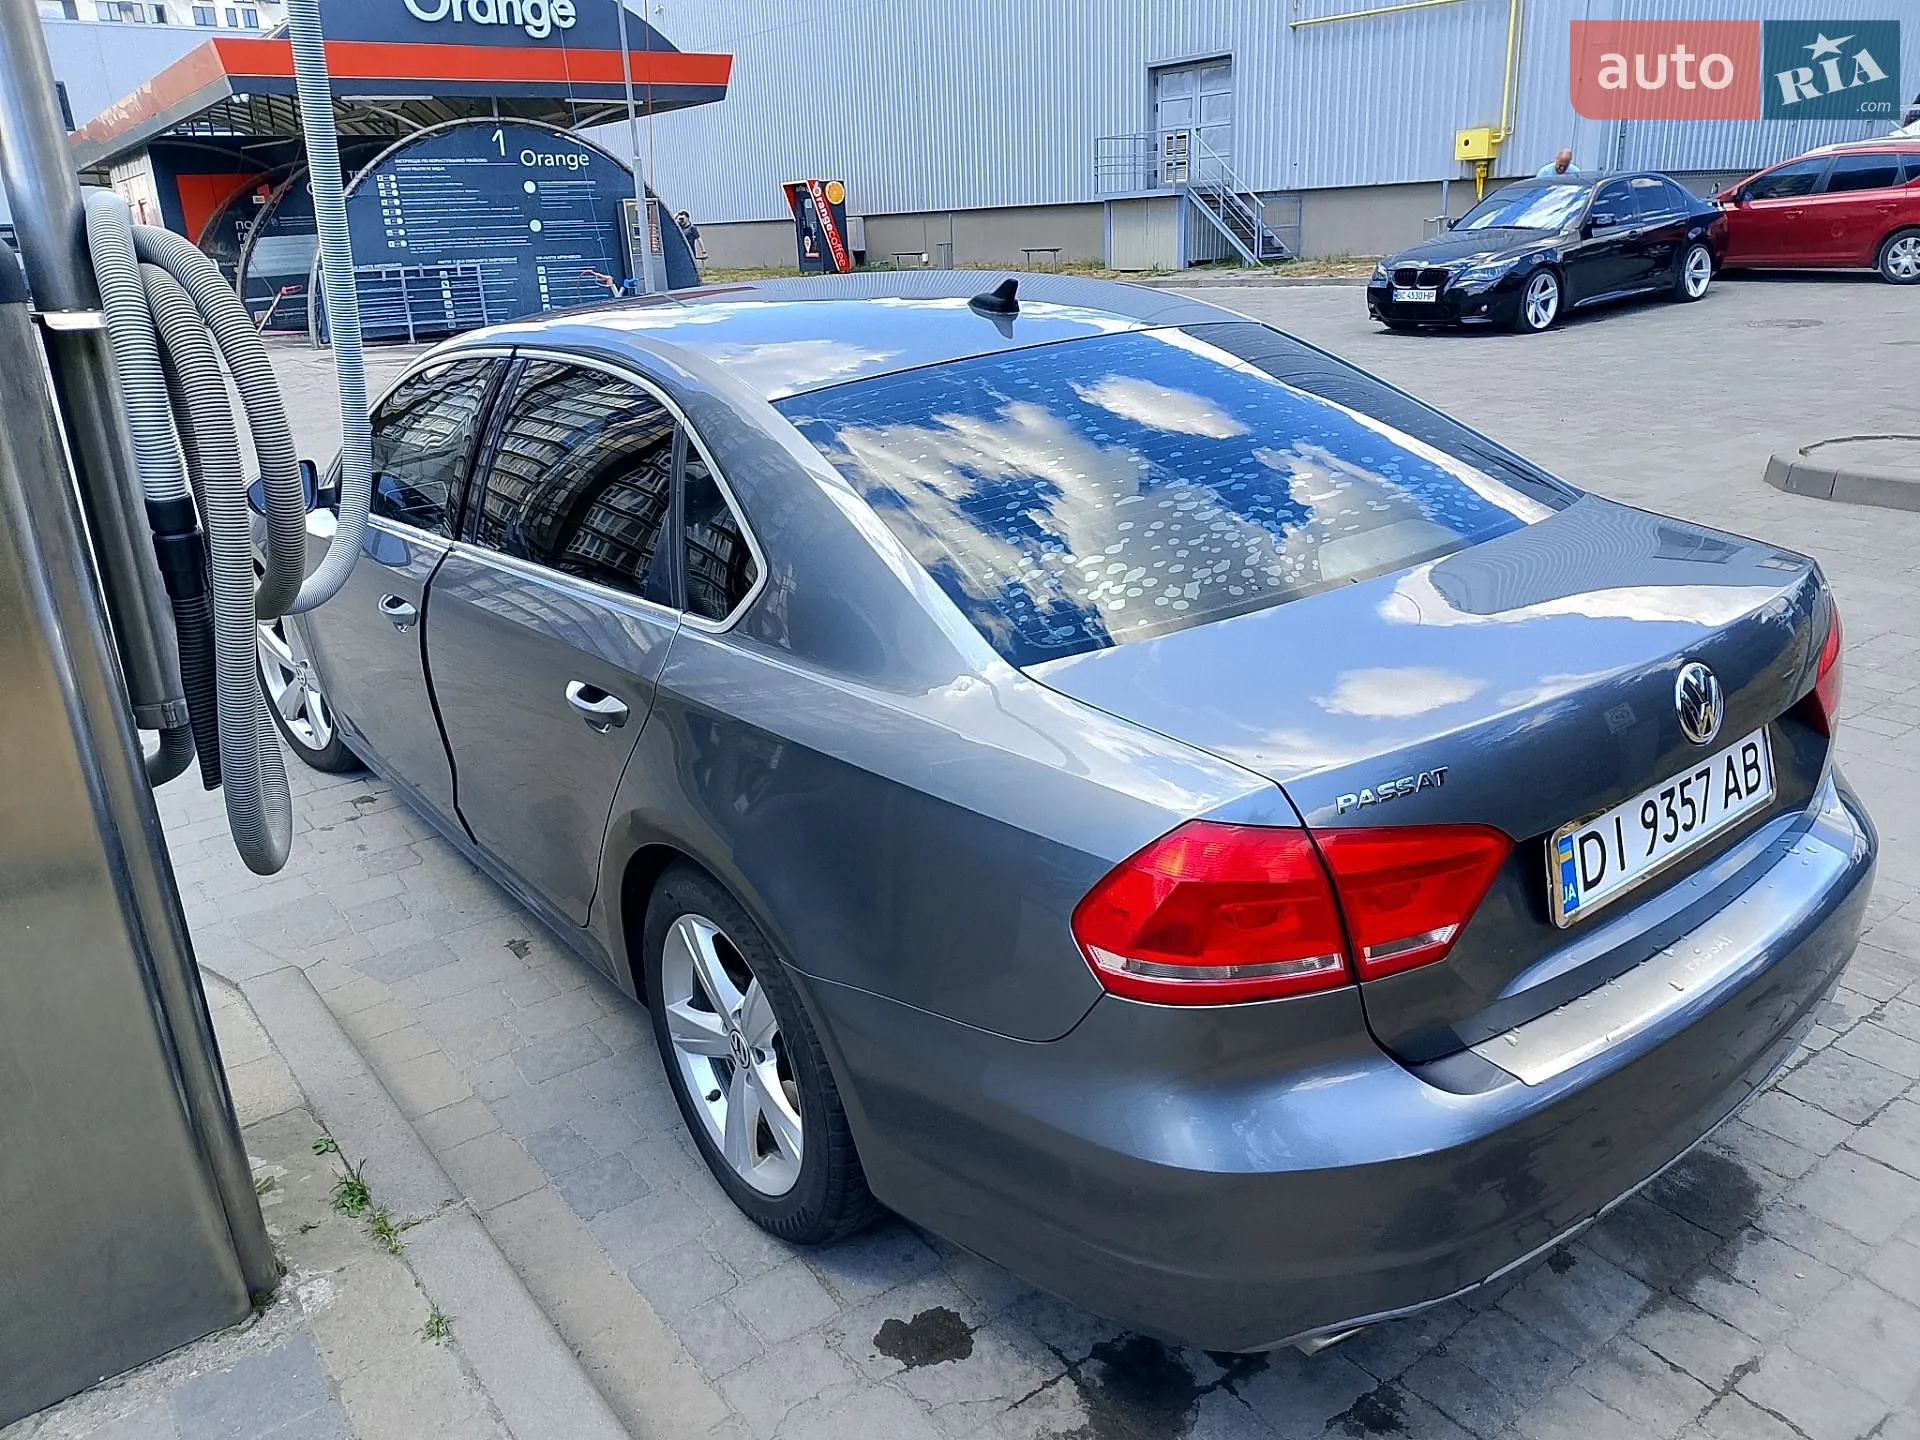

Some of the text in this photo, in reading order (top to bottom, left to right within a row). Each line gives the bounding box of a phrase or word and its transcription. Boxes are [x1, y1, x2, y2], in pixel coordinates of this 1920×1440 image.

[404, 0, 576, 39] Orange
[491, 129, 506, 156] 1
[520, 150, 590, 170] Orange
[1336, 766, 1448, 815] PASSAT
[1578, 742, 1762, 892] DI 9357 AB
